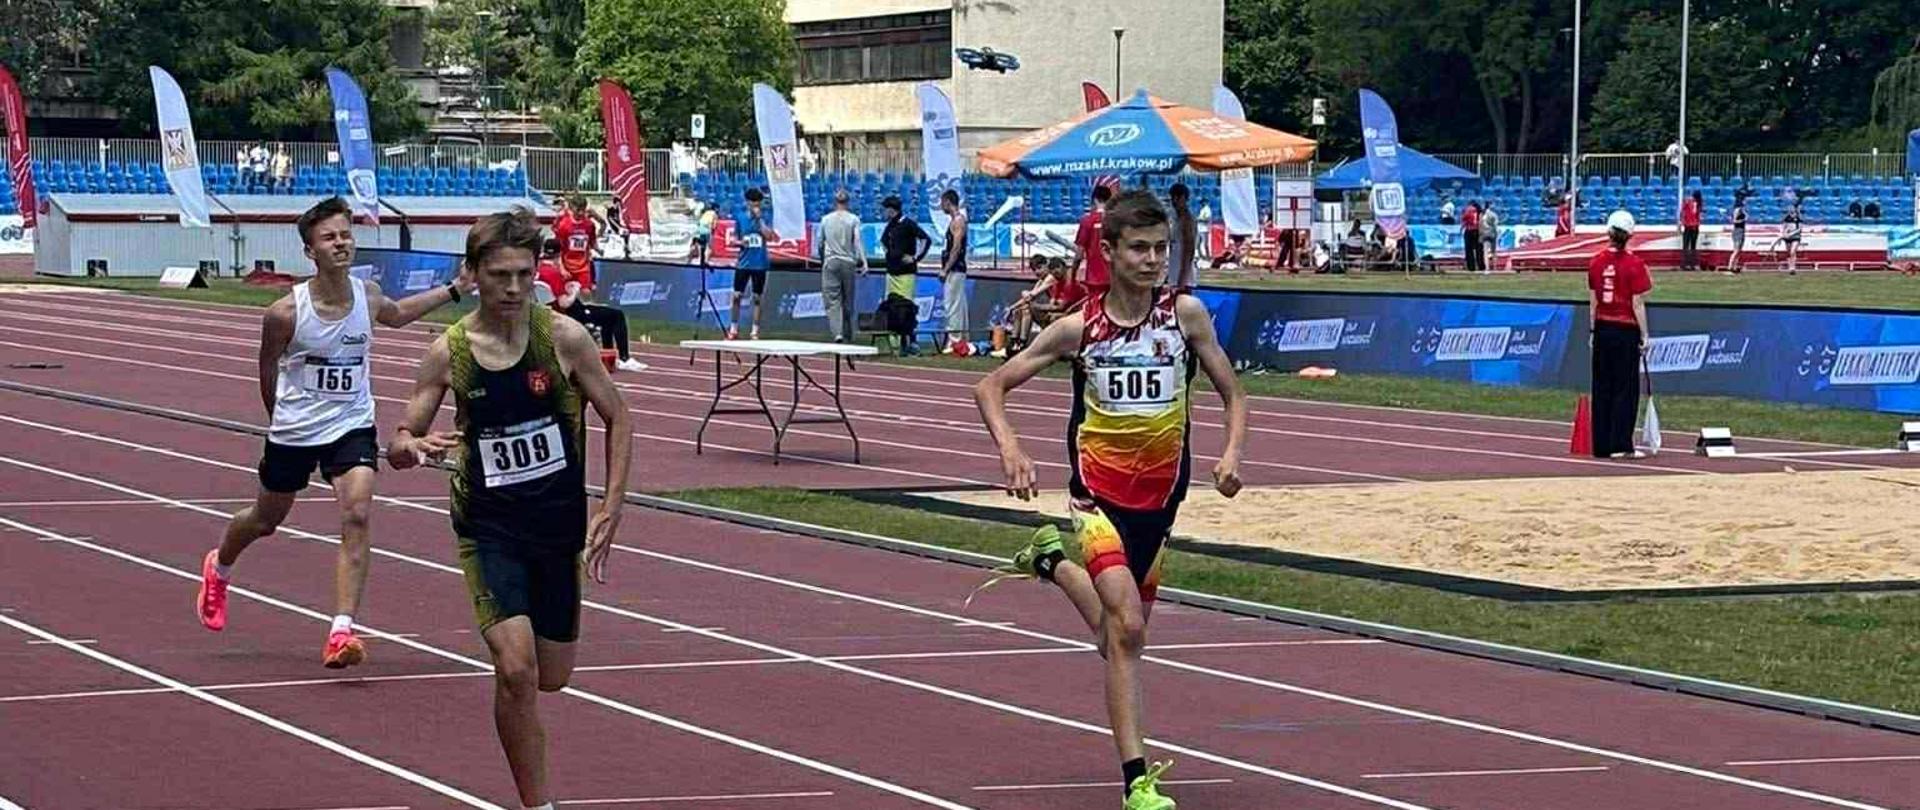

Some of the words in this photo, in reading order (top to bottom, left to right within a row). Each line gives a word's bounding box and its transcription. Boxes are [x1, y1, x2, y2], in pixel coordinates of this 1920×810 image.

[317, 367, 353, 391] 155
[1108, 370, 1161, 400] 505
[491, 432, 551, 472] 309
